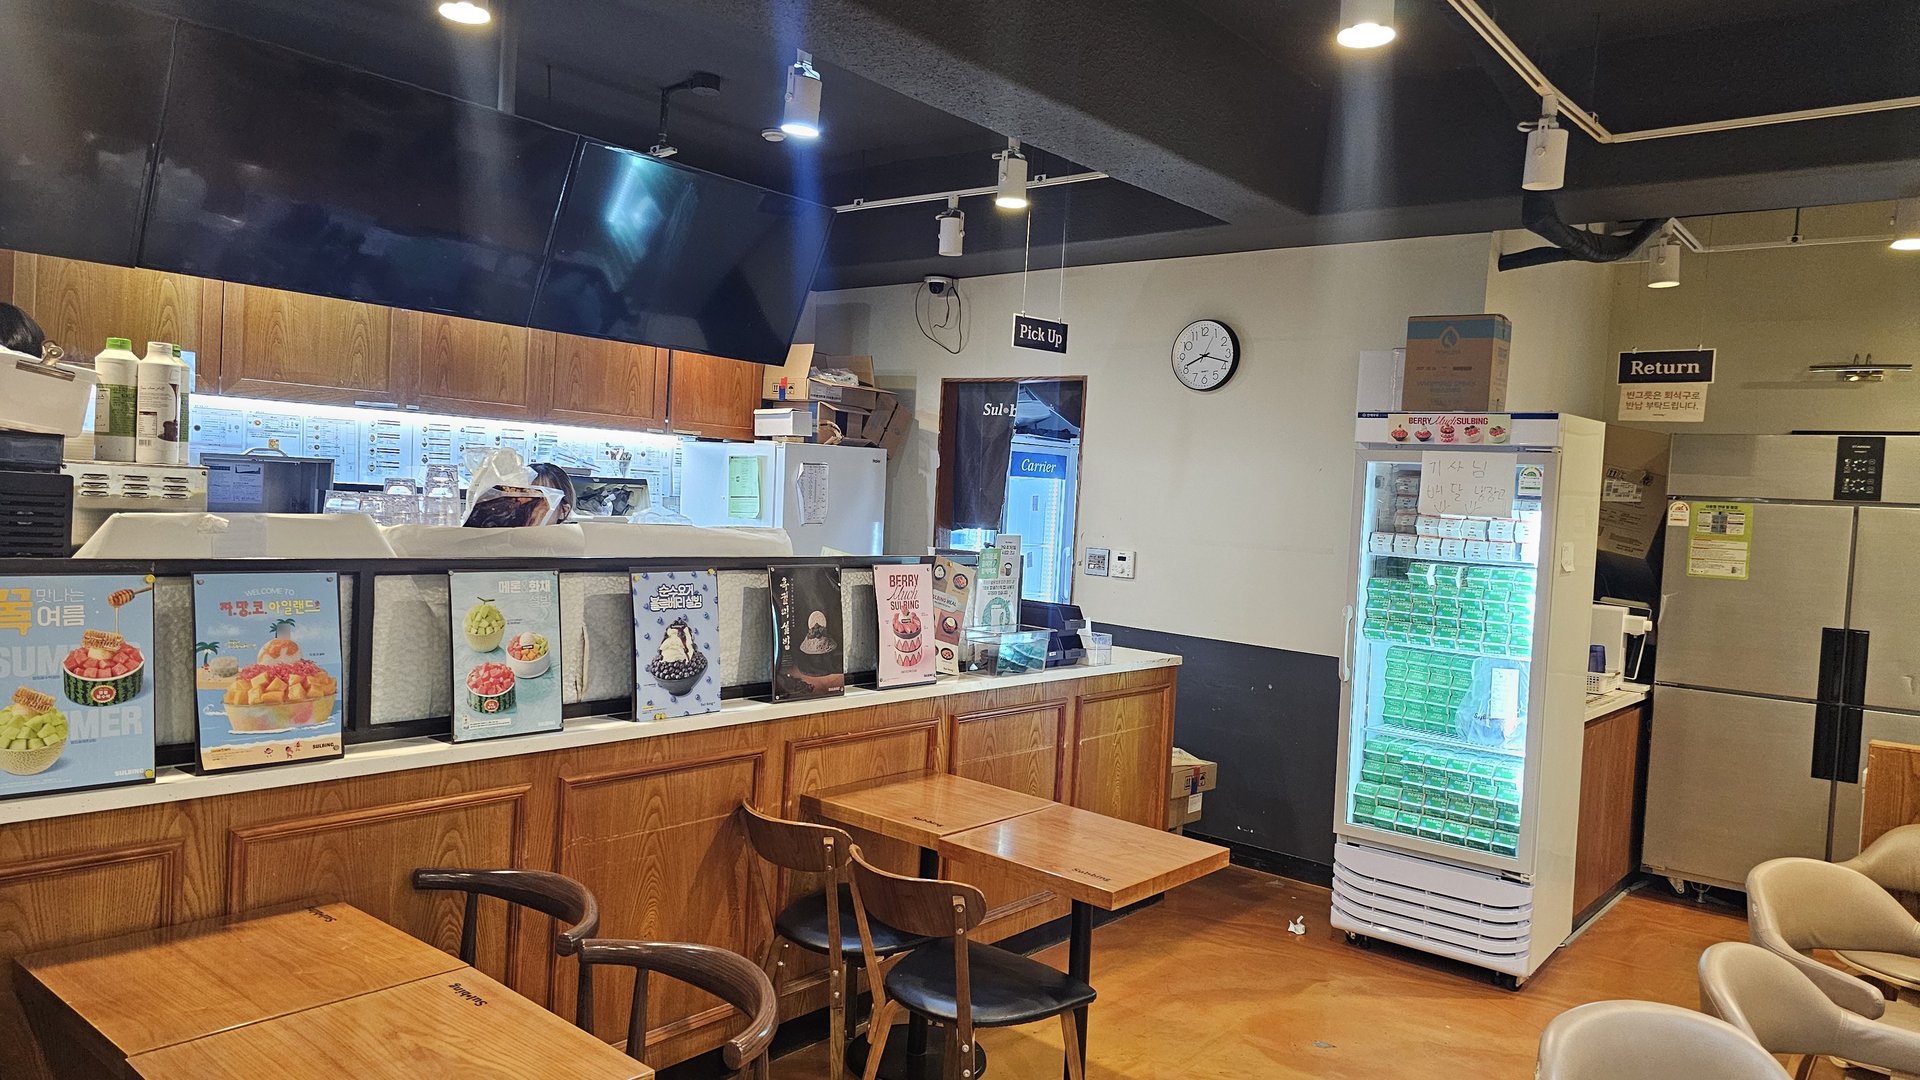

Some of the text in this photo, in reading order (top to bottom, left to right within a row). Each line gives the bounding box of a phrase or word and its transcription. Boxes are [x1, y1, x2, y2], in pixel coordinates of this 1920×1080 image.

[1019, 323, 1063, 348] Pick Up
[1191, 331, 1198, 341] 11
[1201, 326, 1210, 337] 12
[1183, 341, 1193, 351] 10
[1220, 336, 1228, 347] 2
[1179, 352, 1186, 363] 9
[1225, 348, 1232, 358] 3
[1182, 364, 1189, 375] 8
[1630, 360, 1701, 375] Return
[1192, 372, 1198, 382] 7
[1201, 374, 1208, 385] 6
[1212, 370, 1219, 381] 5
[1625, 401, 1699, 411] 반납 부탁드립니다.
[1408, 417, 1432, 425] BERRY
[1456, 417, 1489, 425] SULBING
[1021, 458, 1057, 473] Carrier
[888, 574, 919, 588] BERRY
[35, 588, 86, 603] 맛나는
[244, 587, 295, 597] WELCOME TO
[657, 583, 695, 597] 순수요거
[268, 599, 321, 616] 아일랜드
[37, 604, 86, 627] 여름
